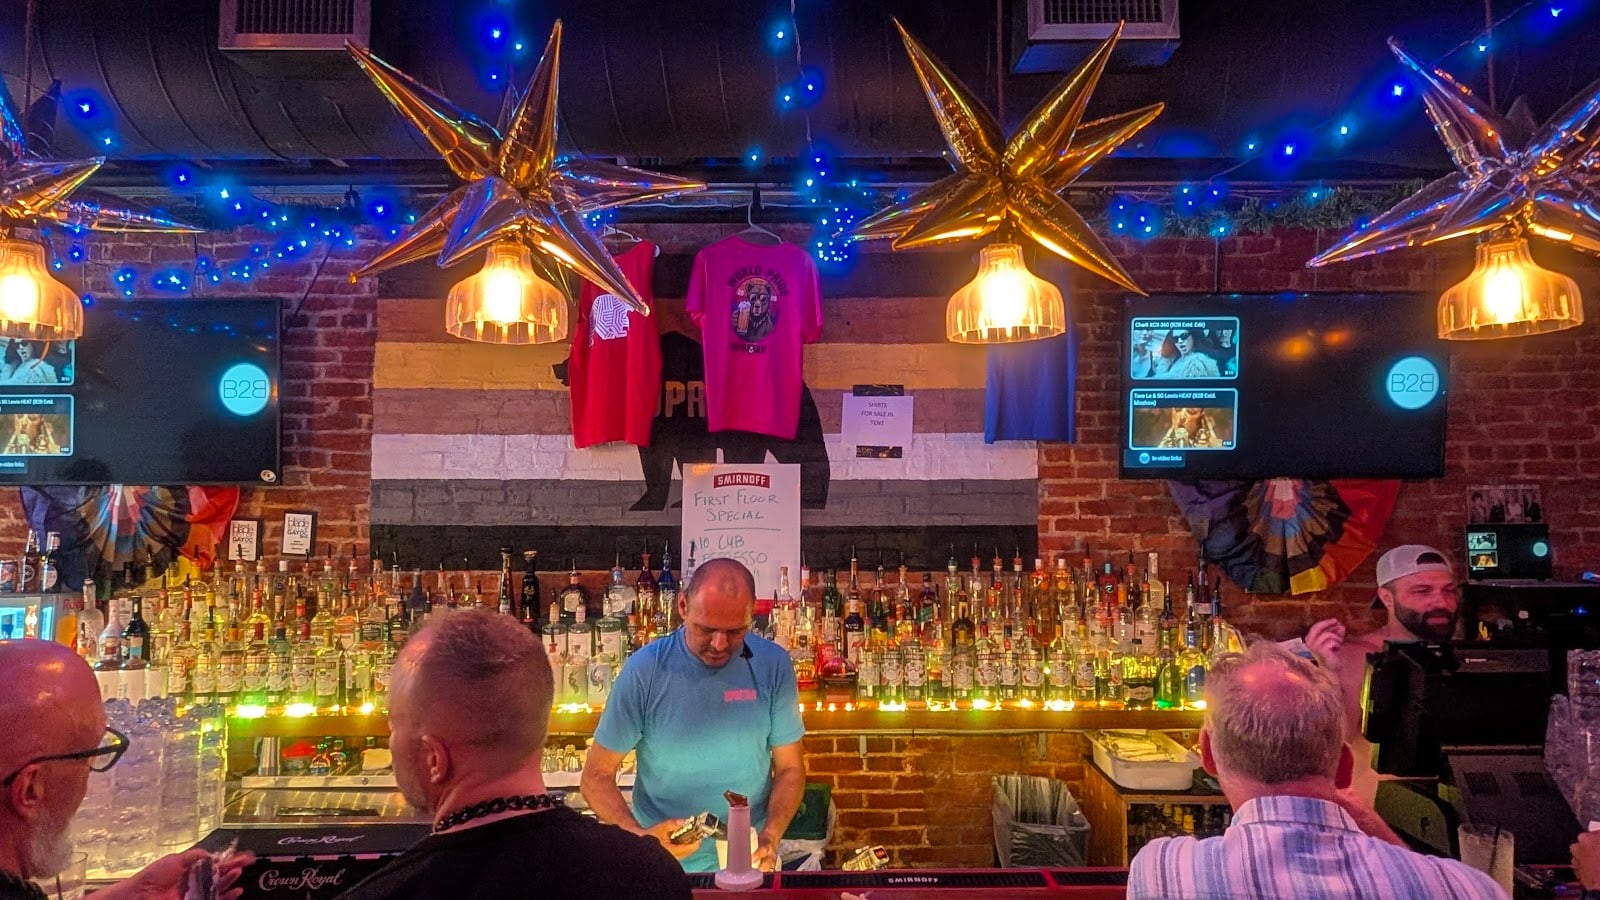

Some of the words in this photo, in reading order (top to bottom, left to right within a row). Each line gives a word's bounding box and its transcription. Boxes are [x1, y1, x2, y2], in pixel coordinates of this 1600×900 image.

[223, 379, 267, 399] B2B
[1391, 373, 1435, 393] B2B
[717, 475, 766, 485] SMIRNOFF
[694, 491, 728, 507] FIRST
[736, 489, 778, 505] FLOOR
[706, 508, 764, 522] SPECIAL
[258, 869, 299, 891] Crown
[288, 864, 346, 890] Royal
